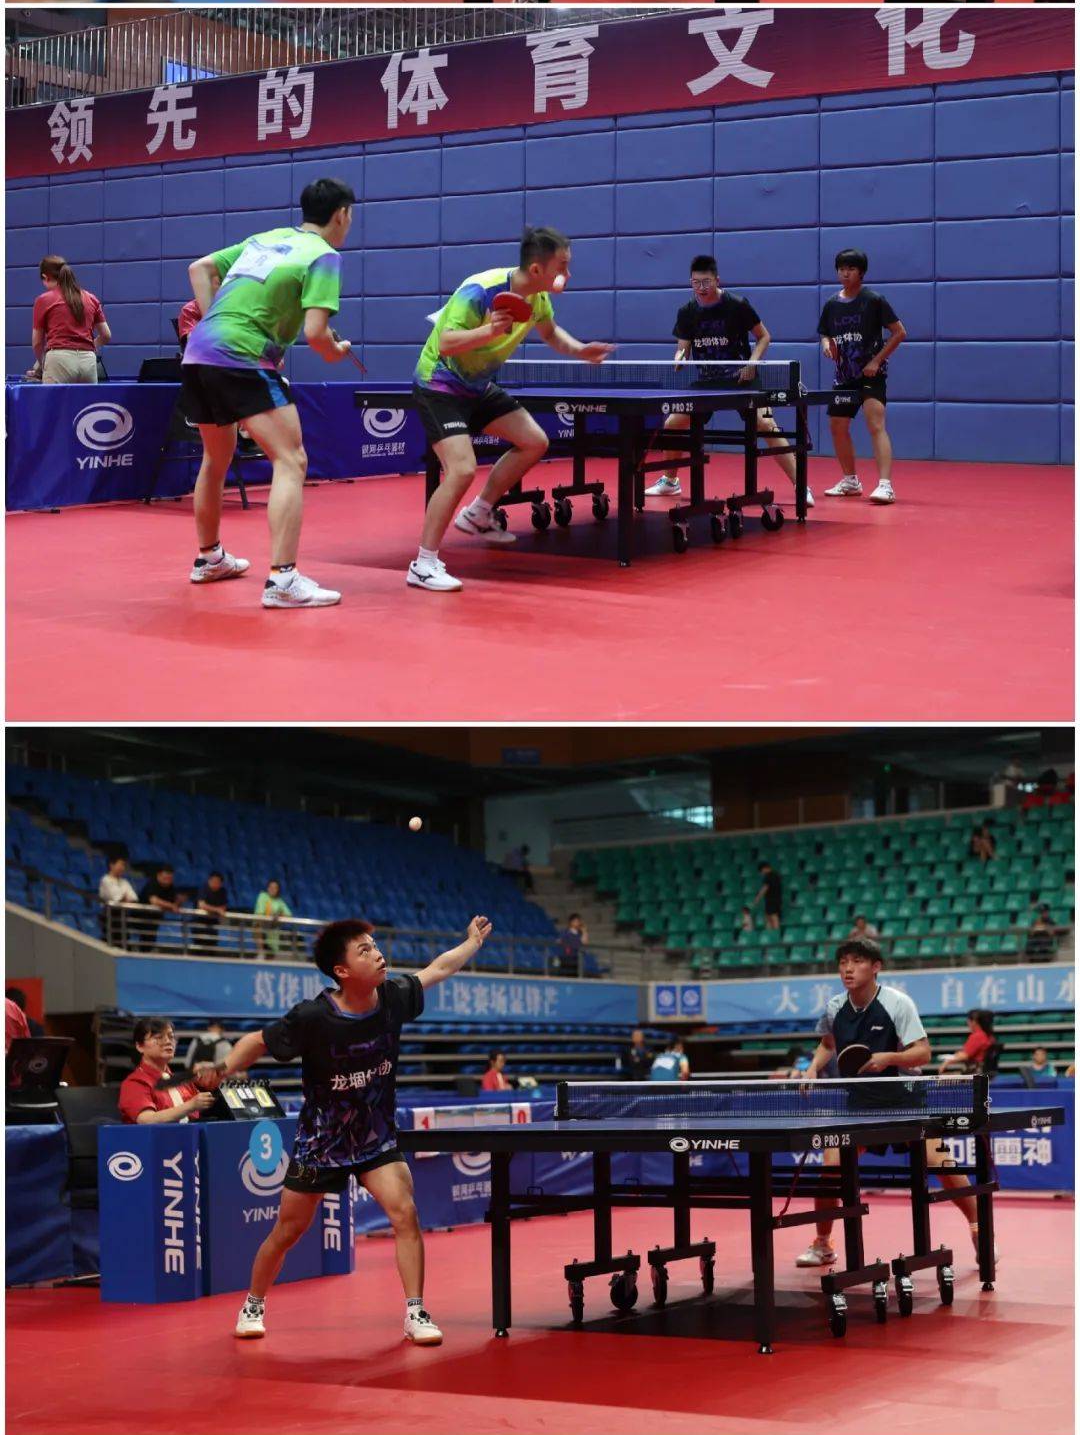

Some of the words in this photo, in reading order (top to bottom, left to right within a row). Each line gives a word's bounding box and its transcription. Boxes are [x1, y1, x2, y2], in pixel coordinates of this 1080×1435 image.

[571, 404, 607, 413] YINHE
[671, 404, 684, 413] PRO
[686, 403, 694, 412] 25
[77, 454, 134, 470] YINHE
[260, 1133, 271, 1159] 3
[691, 1139, 740, 1149] YINHE
[824, 1134, 839, 1146] PRO
[841, 1133, 850, 1145] 25
[163, 1151, 185, 1275] YINHE
